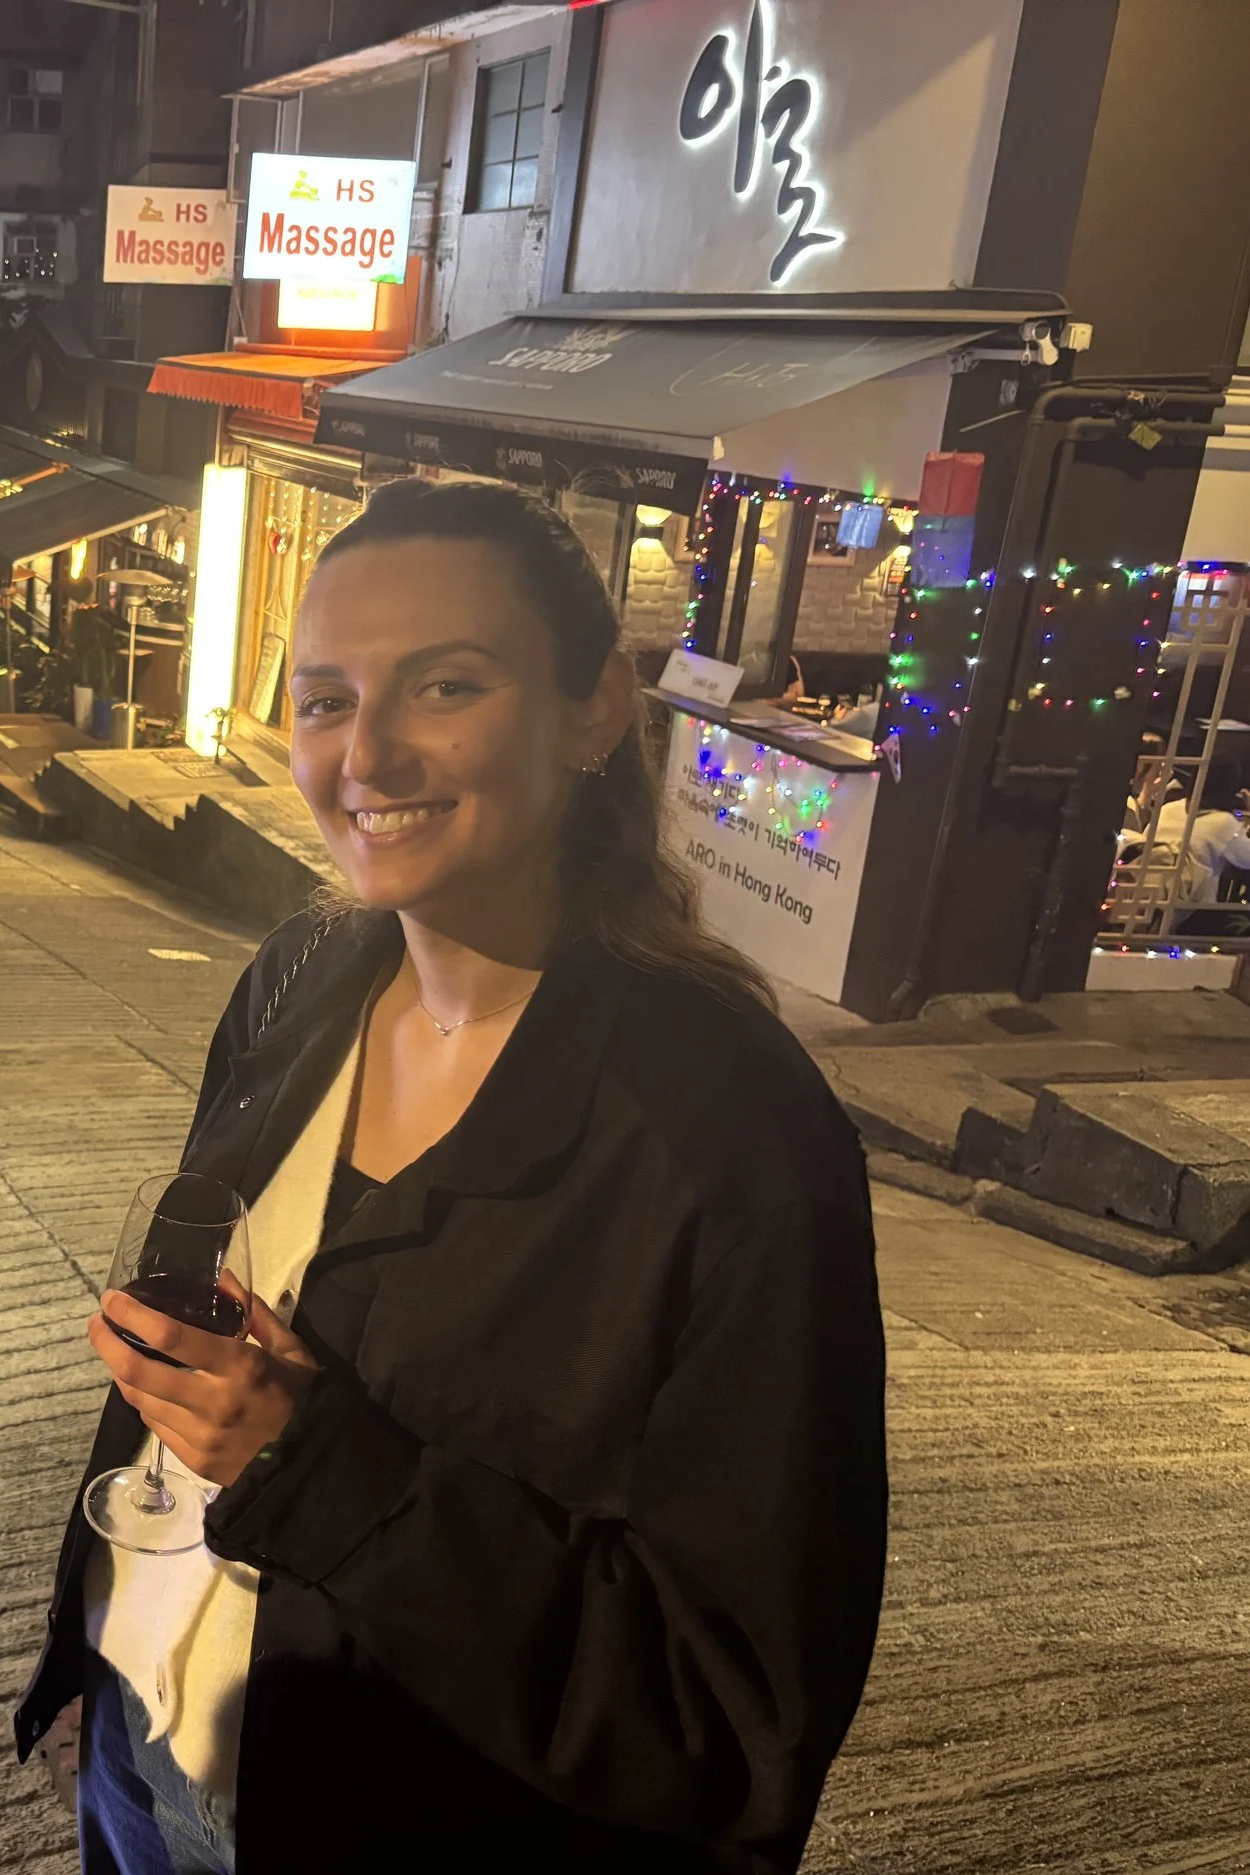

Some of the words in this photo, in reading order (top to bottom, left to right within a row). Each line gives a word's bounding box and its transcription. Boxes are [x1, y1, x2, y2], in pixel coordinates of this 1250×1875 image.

[336, 178, 376, 203] HS
[175, 203, 208, 223] HS
[114, 229, 225, 275] Massage
[258, 212, 396, 269] Massage
[488, 347, 613, 374] SAPPORO
[508, 449, 543, 469] SAPPORO
[635, 467, 676, 490] SAPPORO
[685, 839, 716, 869] ARO
[718, 855, 731, 879] in
[734, 863, 771, 903] Hong
[775, 884, 814, 924] Kong
